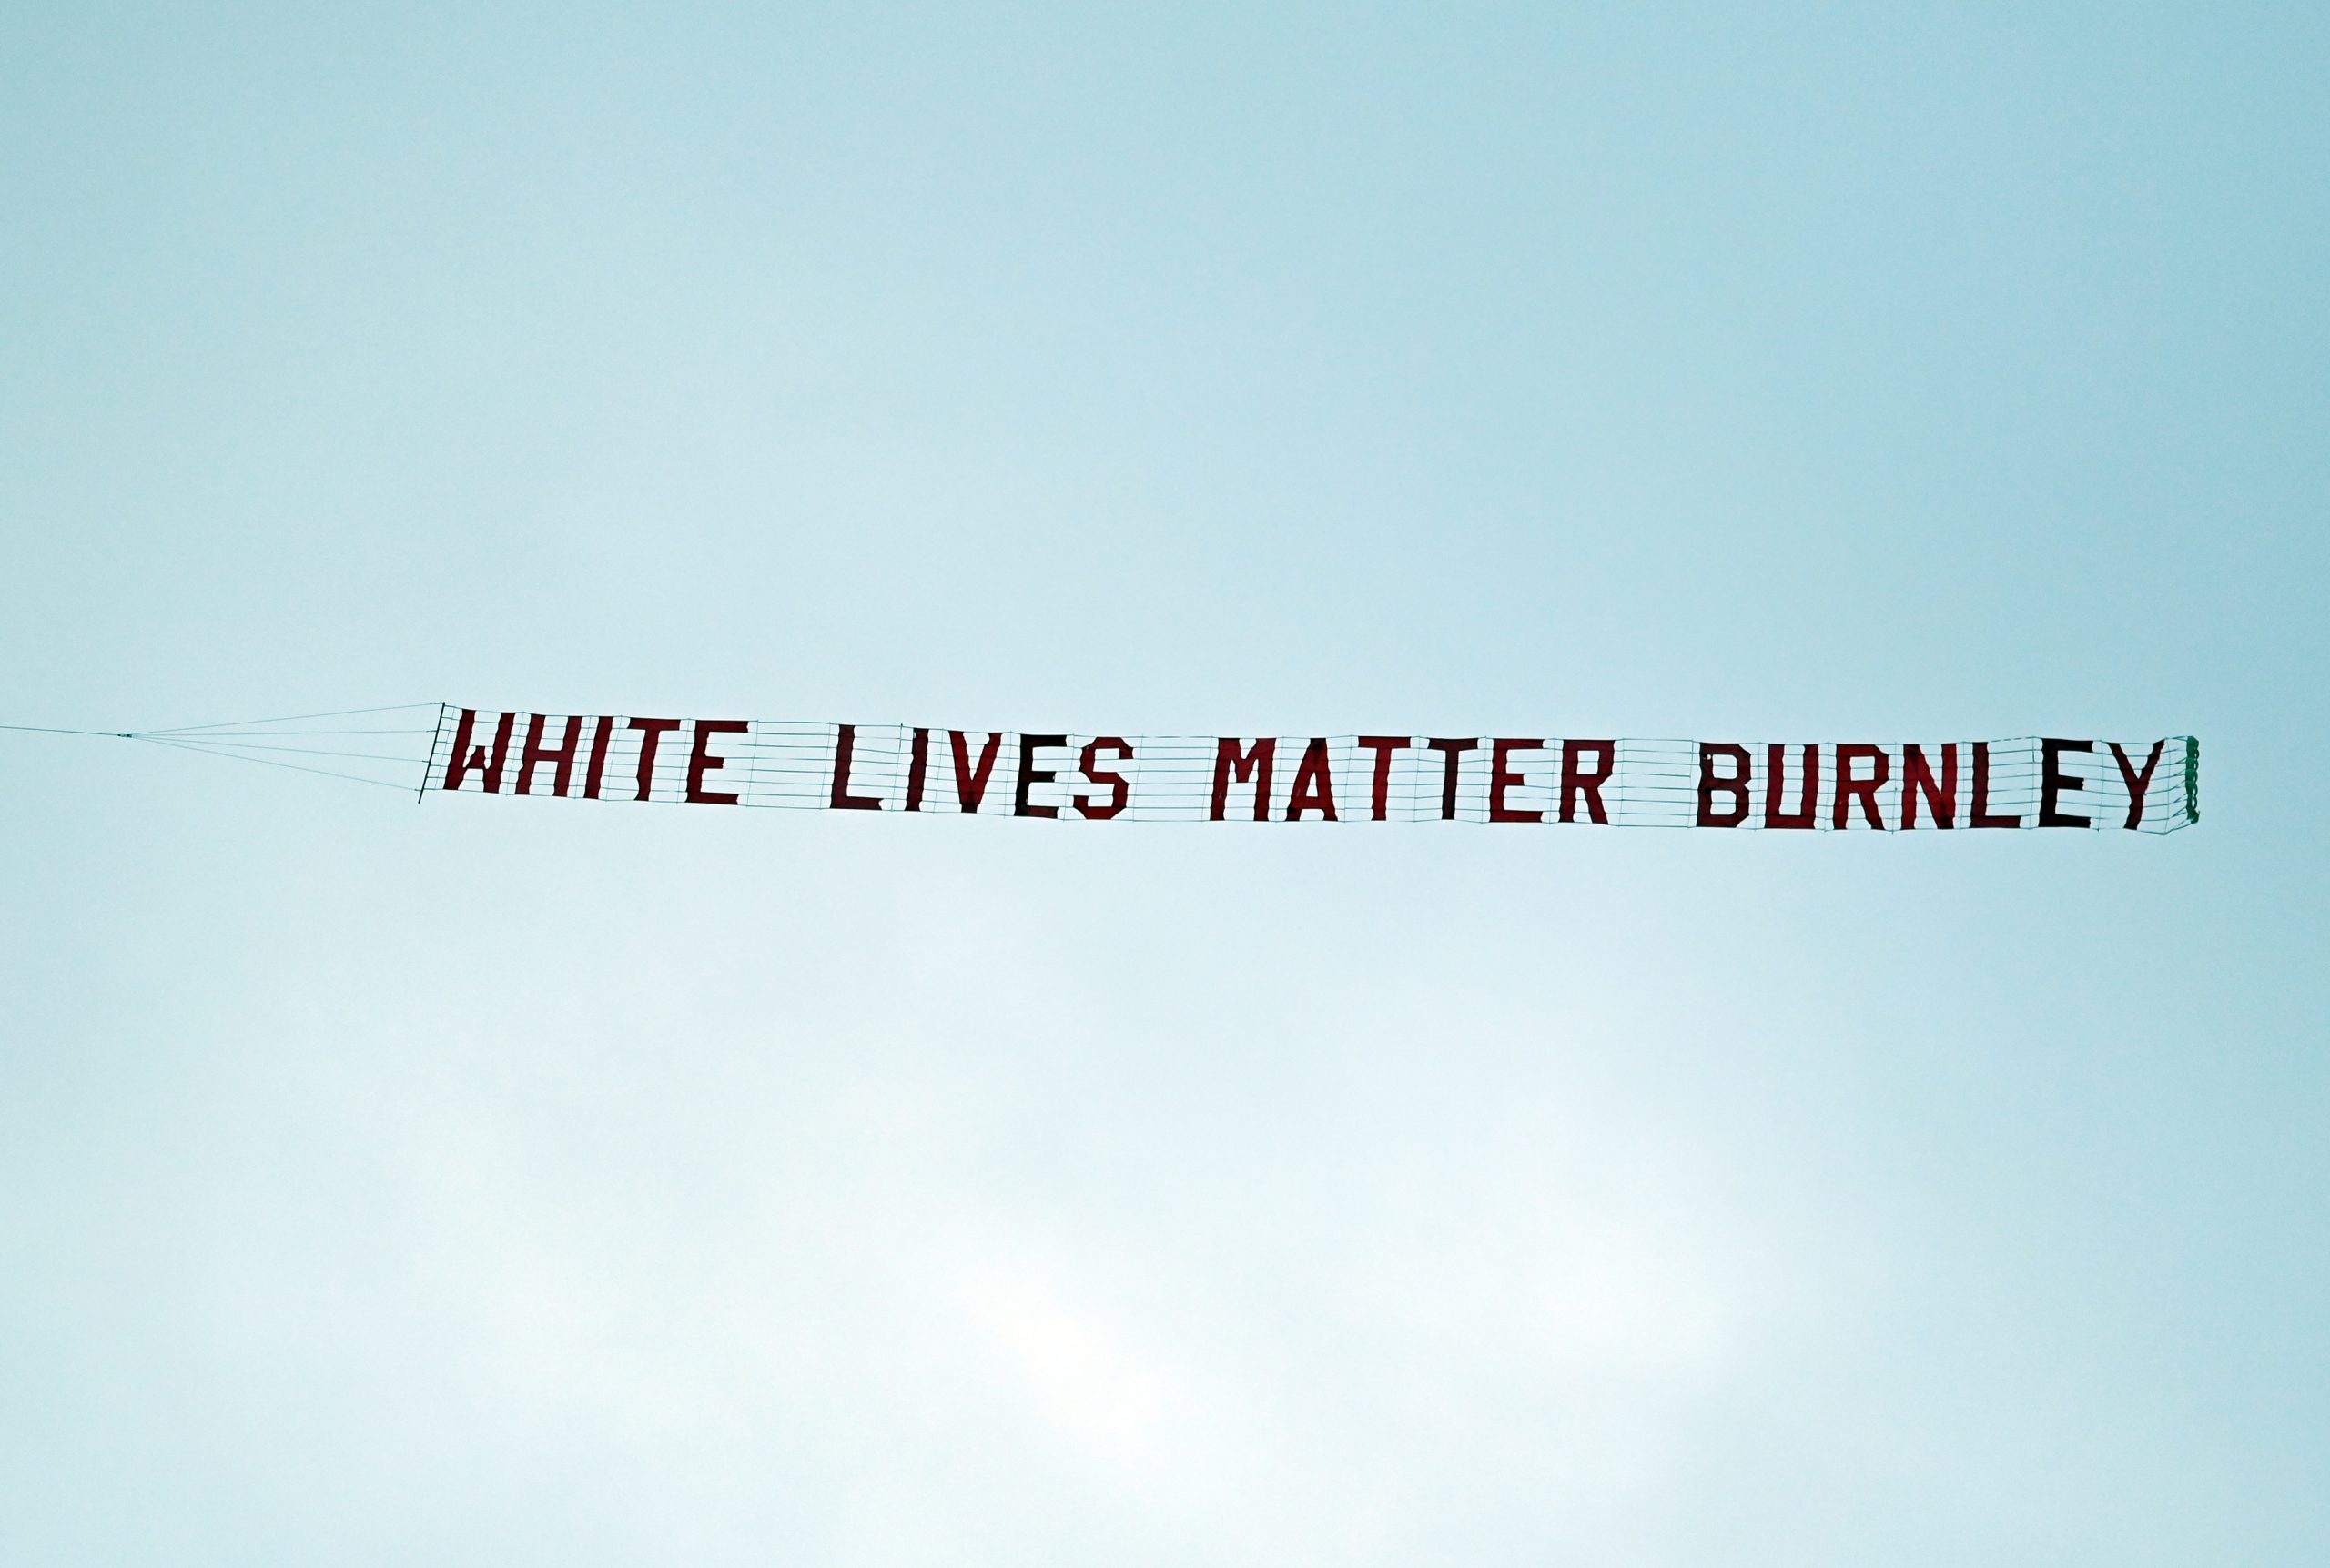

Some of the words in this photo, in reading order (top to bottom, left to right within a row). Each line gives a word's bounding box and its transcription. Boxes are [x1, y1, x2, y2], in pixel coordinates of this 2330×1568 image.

[443, 708, 750, 806] WHITE
[829, 723, 1134, 821] LIVES
[1209, 735, 1616, 825] MATTER
[1696, 737, 2166, 831] BURNLEY
